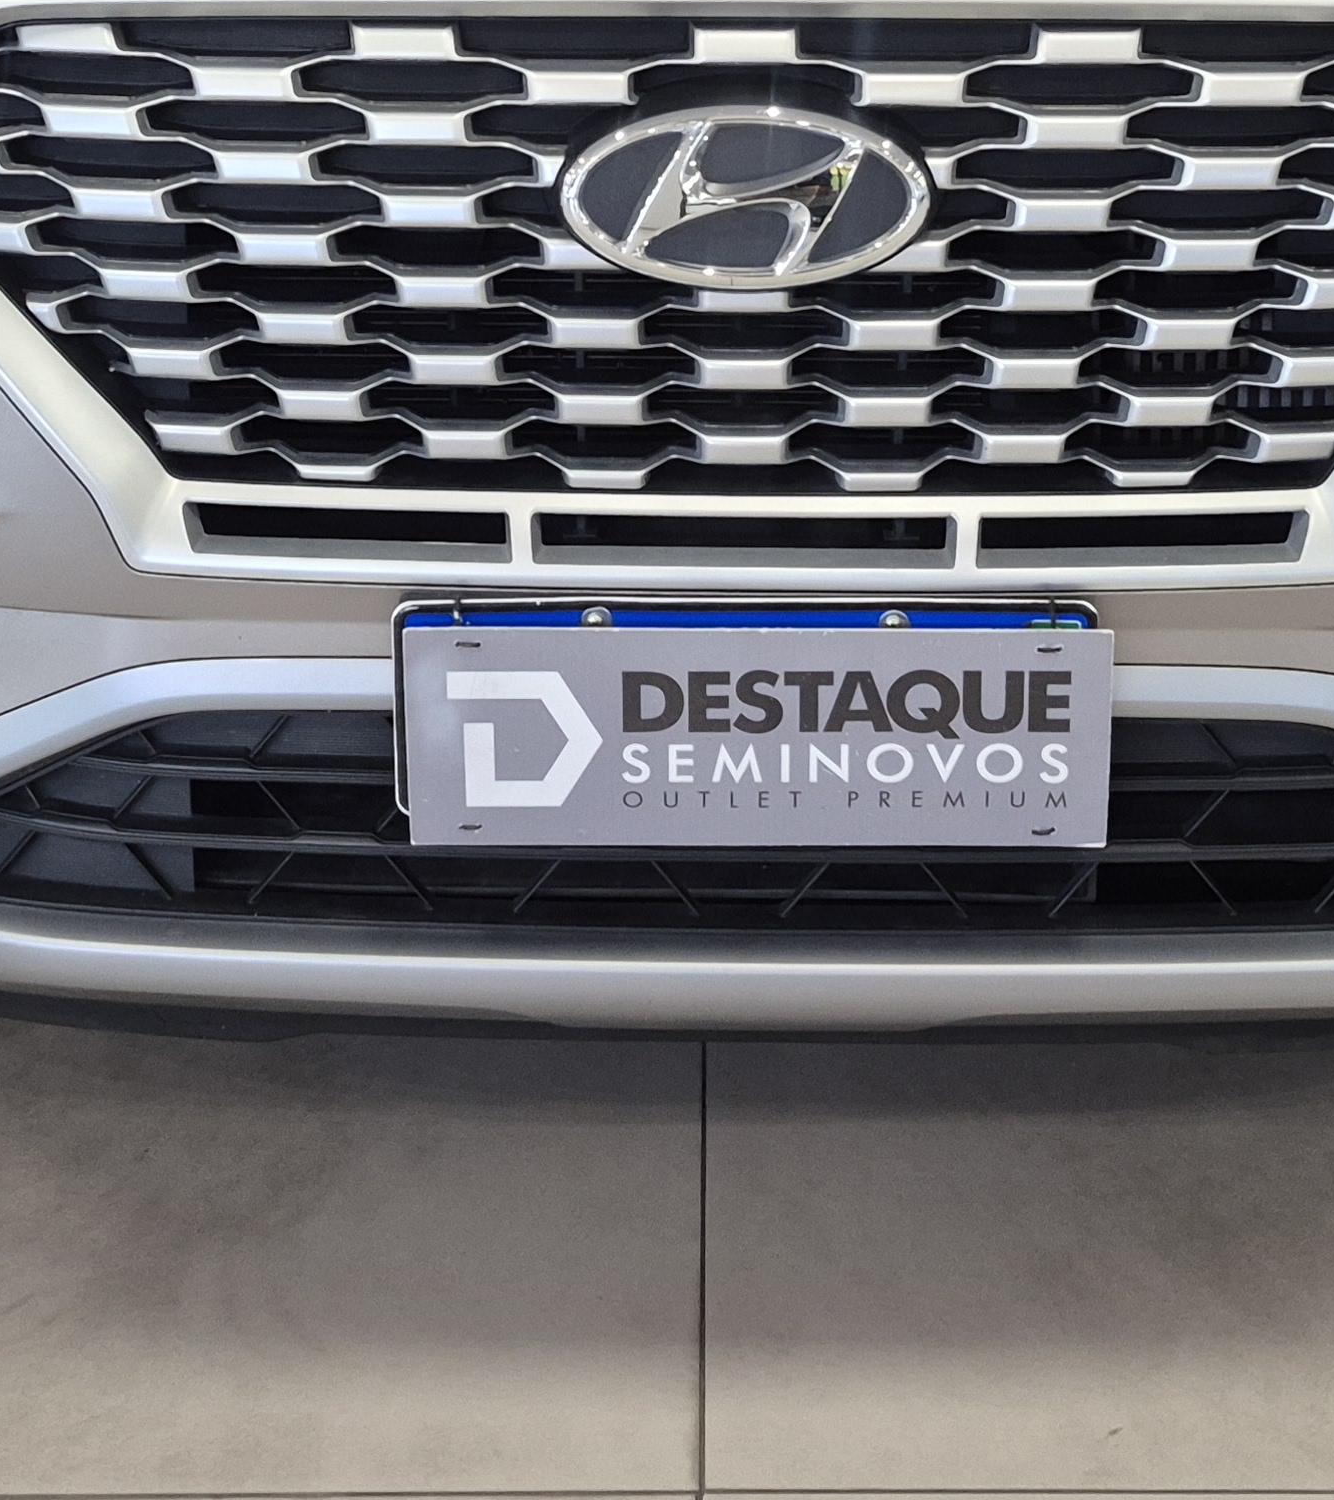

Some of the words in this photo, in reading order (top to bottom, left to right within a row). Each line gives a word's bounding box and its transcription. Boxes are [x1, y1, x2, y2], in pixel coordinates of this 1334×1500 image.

[620, 669, 1073, 740] DESTAQUE
[620, 741, 1071, 785] SEMINOVOS
[622, 789, 803, 810] OUTLET
[847, 789, 1069, 810] PREMIUM
